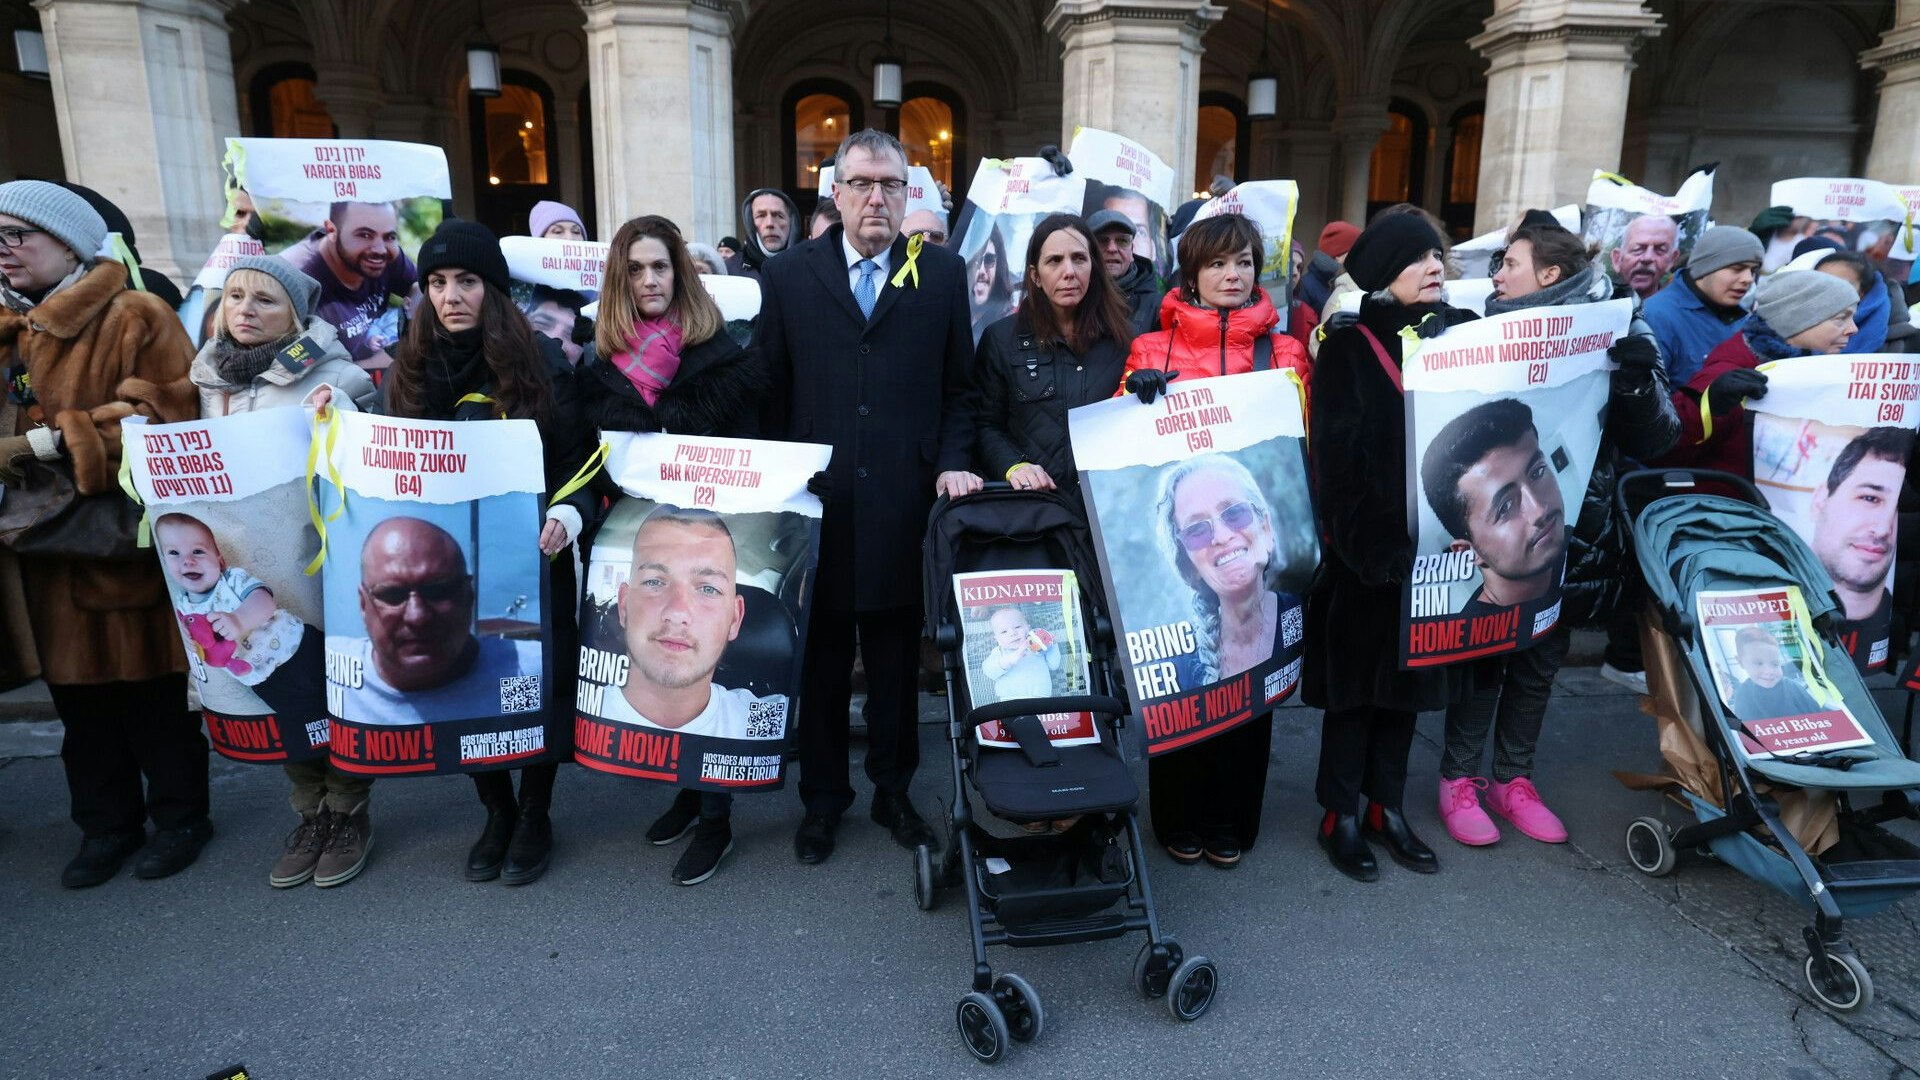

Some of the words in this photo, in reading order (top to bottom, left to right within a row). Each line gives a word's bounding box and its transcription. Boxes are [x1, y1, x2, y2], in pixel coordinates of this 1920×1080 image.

[314, 146, 341, 162] ביבס
[344, 147, 365, 163] ירדן
[303, 164, 346, 179] YARDEN
[348, 165, 382, 180] BIBAS
[334, 181, 357, 198] (34)
[542, 257, 562, 270] GALI
[564, 258, 582, 271] AND
[584, 260, 597, 272] ZIV
[580, 274, 598, 288] (26)
[1502, 318, 1542, 340] סמרנו
[1546, 316, 1573, 338] יונתן
[1422, 344, 1495, 372] YONATHAN
[1498, 340, 1570, 363] MORDECHAI
[1569, 330, 1614, 356] SAMERANO
[1528, 362, 1548, 386] (21)
[1191, 388, 1215, 407] מיה
[1848, 382, 1878, 400] ITAI
[1164, 392, 1190, 414] גורן
[1878, 402, 1904, 424] (38)
[1155, 411, 1198, 436] GOREN
[1198, 406, 1232, 427] MAYA
[144, 434, 177, 454] ביבס
[174, 429, 212, 452] כפיר
[370, 424, 398, 448] זוקוב
[402, 428, 454, 450] ולדימיר
[1186, 428, 1214, 452] (56)
[146, 456, 178, 476] KFIR
[176, 452, 224, 474] BIBAS
[362, 446, 416, 472] VLADIMIR
[420, 453, 466, 474] ZUKOV
[738, 450, 752, 467] בר
[395, 473, 422, 498] (64)
[660, 462, 682, 482] BAR
[684, 464, 762, 488] KUPERSHTEIN
[694, 484, 716, 507] (22)
[1412, 550, 1475, 586] BRING
[1410, 584, 1450, 618] HIM
[1410, 619, 1468, 654] HOME
[1469, 604, 1521, 647] NOW!
[1126, 620, 1197, 665] BRING
[578, 645, 630, 688] BRING
[1133, 661, 1181, 701] HER
[576, 679, 604, 717] HIM
[1142, 694, 1201, 740] HOME
[1204, 672, 1252, 722] NOW!
[222, 715, 284, 749] NOW!
[460, 732, 499, 748] HOSTAGES
[499, 731, 513, 742] AND
[513, 725, 544, 741] MISSING
[1051, 724, 1068, 736] old
[1754, 721, 1788, 737] Ariel
[1790, 718, 1832, 736] Bibas
[366, 725, 436, 762] NOW!
[460, 741, 508, 760] FAMILIES
[509, 736, 544, 756] FORUM
[574, 716, 616, 759] HOME
[618, 728, 681, 770] NOW!
[1774, 738, 1782, 748] 4
[1783, 736, 1810, 752] years
[1810, 732, 1828, 742] old
[702, 752, 739, 766] HOSTAGES
[738, 754, 753, 766] AND
[752, 755, 781, 767] MISSING
[701, 762, 745, 781] FAMILIES
[746, 765, 780, 781] FORUM
